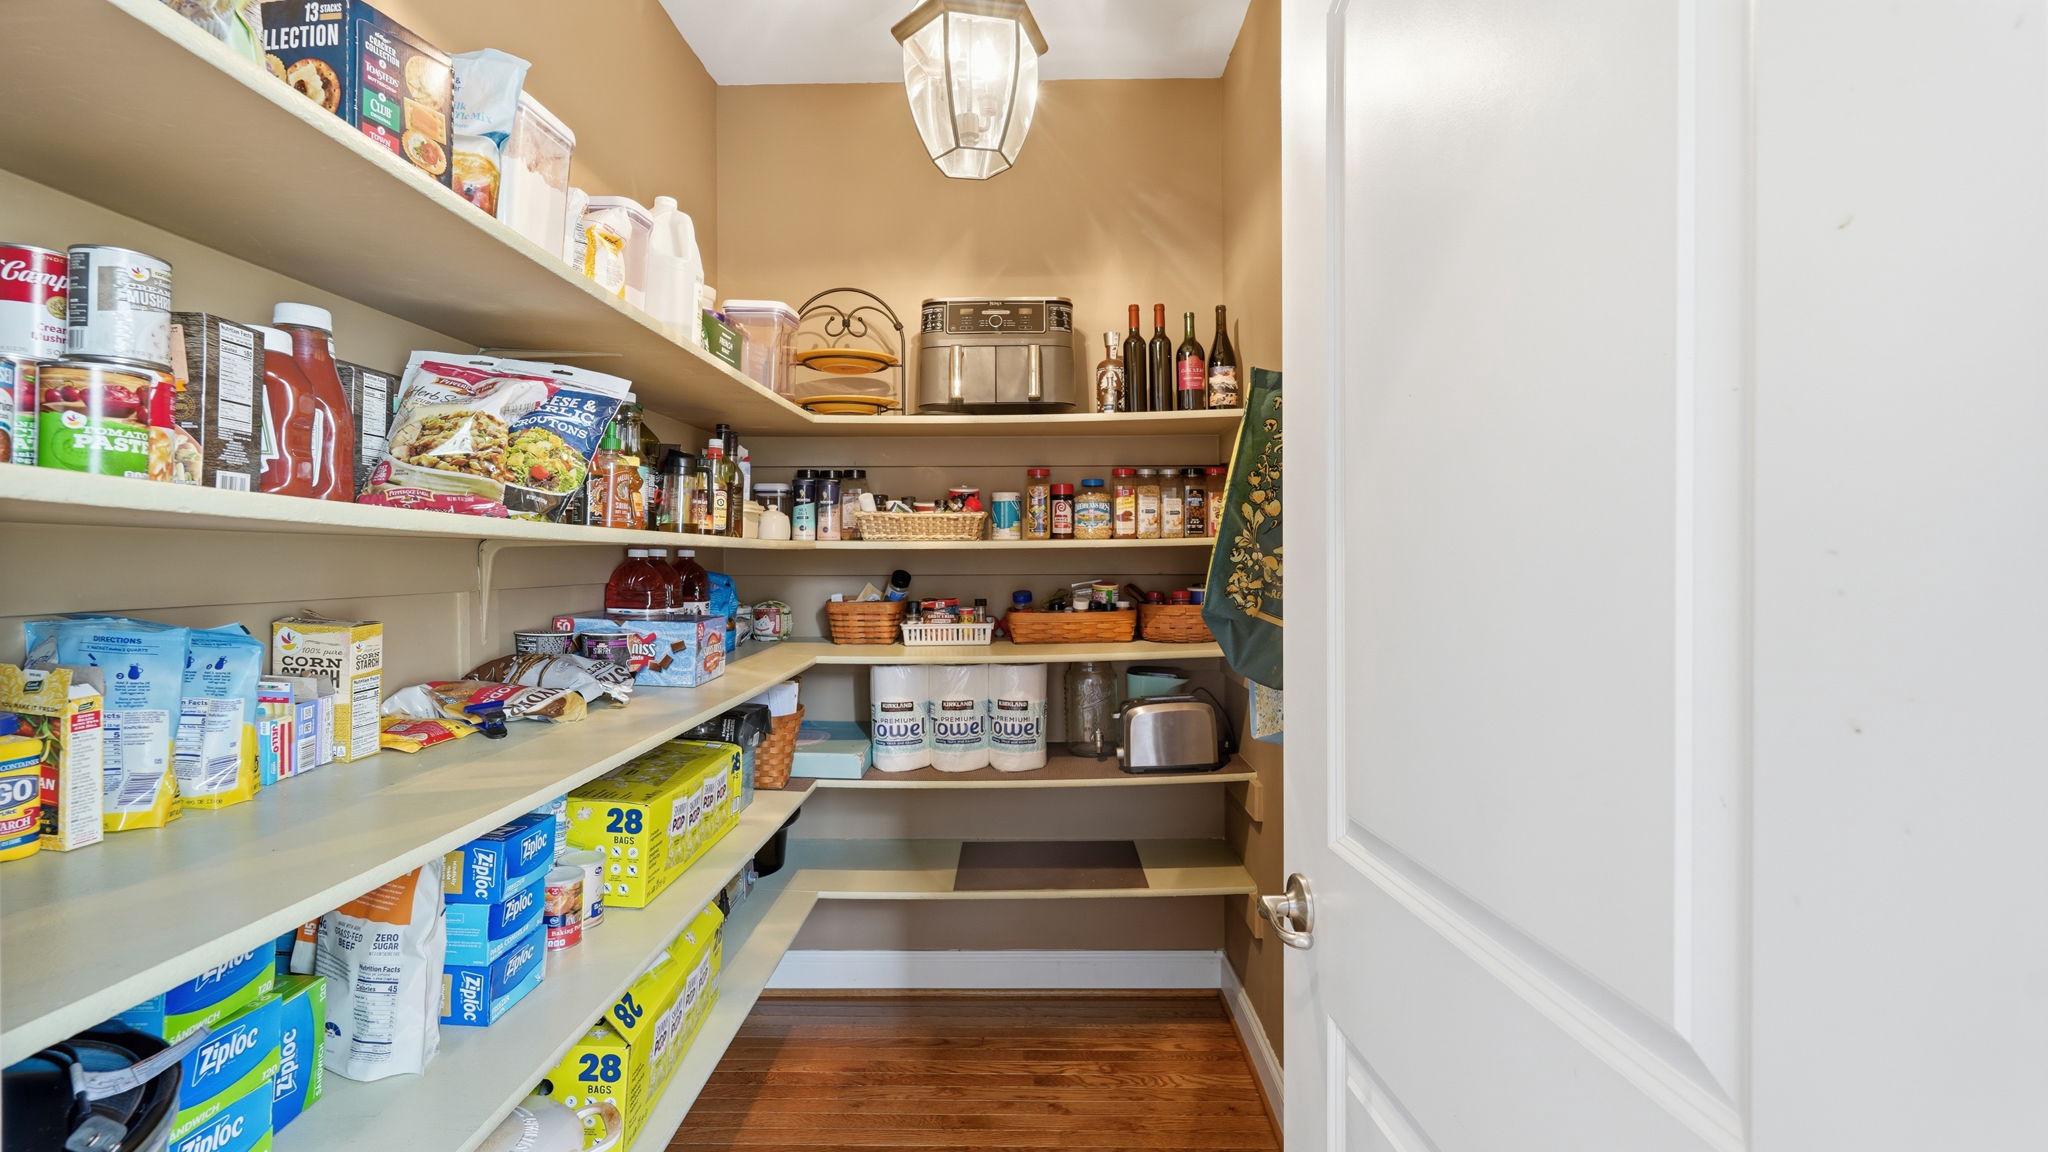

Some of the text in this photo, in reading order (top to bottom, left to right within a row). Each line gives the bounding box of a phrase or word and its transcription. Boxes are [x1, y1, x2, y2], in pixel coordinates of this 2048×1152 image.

[304, 2, 342, 22] 13 STACKS
[365, 41, 400, 68] COLLECTION
[369, 35, 397, 57] CRACKER
[365, 60, 400, 87] TOASTEDS
[412, 385, 439, 401] Herb
[583, 400, 596, 413] &
[82, 426, 148, 443] TOMATO
[512, 415, 588, 439] CROUTONS
[93, 635, 142, 645] DIRECTIONS
[282, 656, 342, 668] CORN
[323, 648, 343, 656] pure
[356, 651, 380, 661] CORN
[356, 658, 380, 671] STARCH
[943, 700, 973, 708] KIRKLAND
[998, 700, 1028, 708] KIRKLAND
[873, 717, 926, 738] Towel
[931, 716, 985, 736] Towel
[990, 716, 1040, 736] Towel
[39, 780, 55, 791] AN
[606, 807, 643, 835] 28
[671, 815, 686, 832] POP
[521, 832, 547, 861] Ziploc
[614, 836, 635, 846] BAGS
[472, 853, 494, 899] Ziploc
[505, 893, 533, 920] Ziploc
[373, 942, 399, 950] SUGAR
[375, 933, 399, 942] ZERO
[359, 964, 382, 973] Nutrition
[507, 946, 534, 976] Ziploc
[319, 983, 328, 1003] 120
[356, 984, 398, 993] Calories 45
[460, 977, 481, 1021] Ziploc
[614, 992, 643, 1029] 28
[199, 1027, 259, 1074] Ziploc
[262, 1063, 278, 1081] 120
[276, 1028, 299, 1097] Ziploc
[315, 1043, 324, 1097] SANDWICH
[578, 1053, 622, 1083] 28
[587, 1085, 612, 1094] BAGS
[182, 1115, 245, 1152] Ziploc
